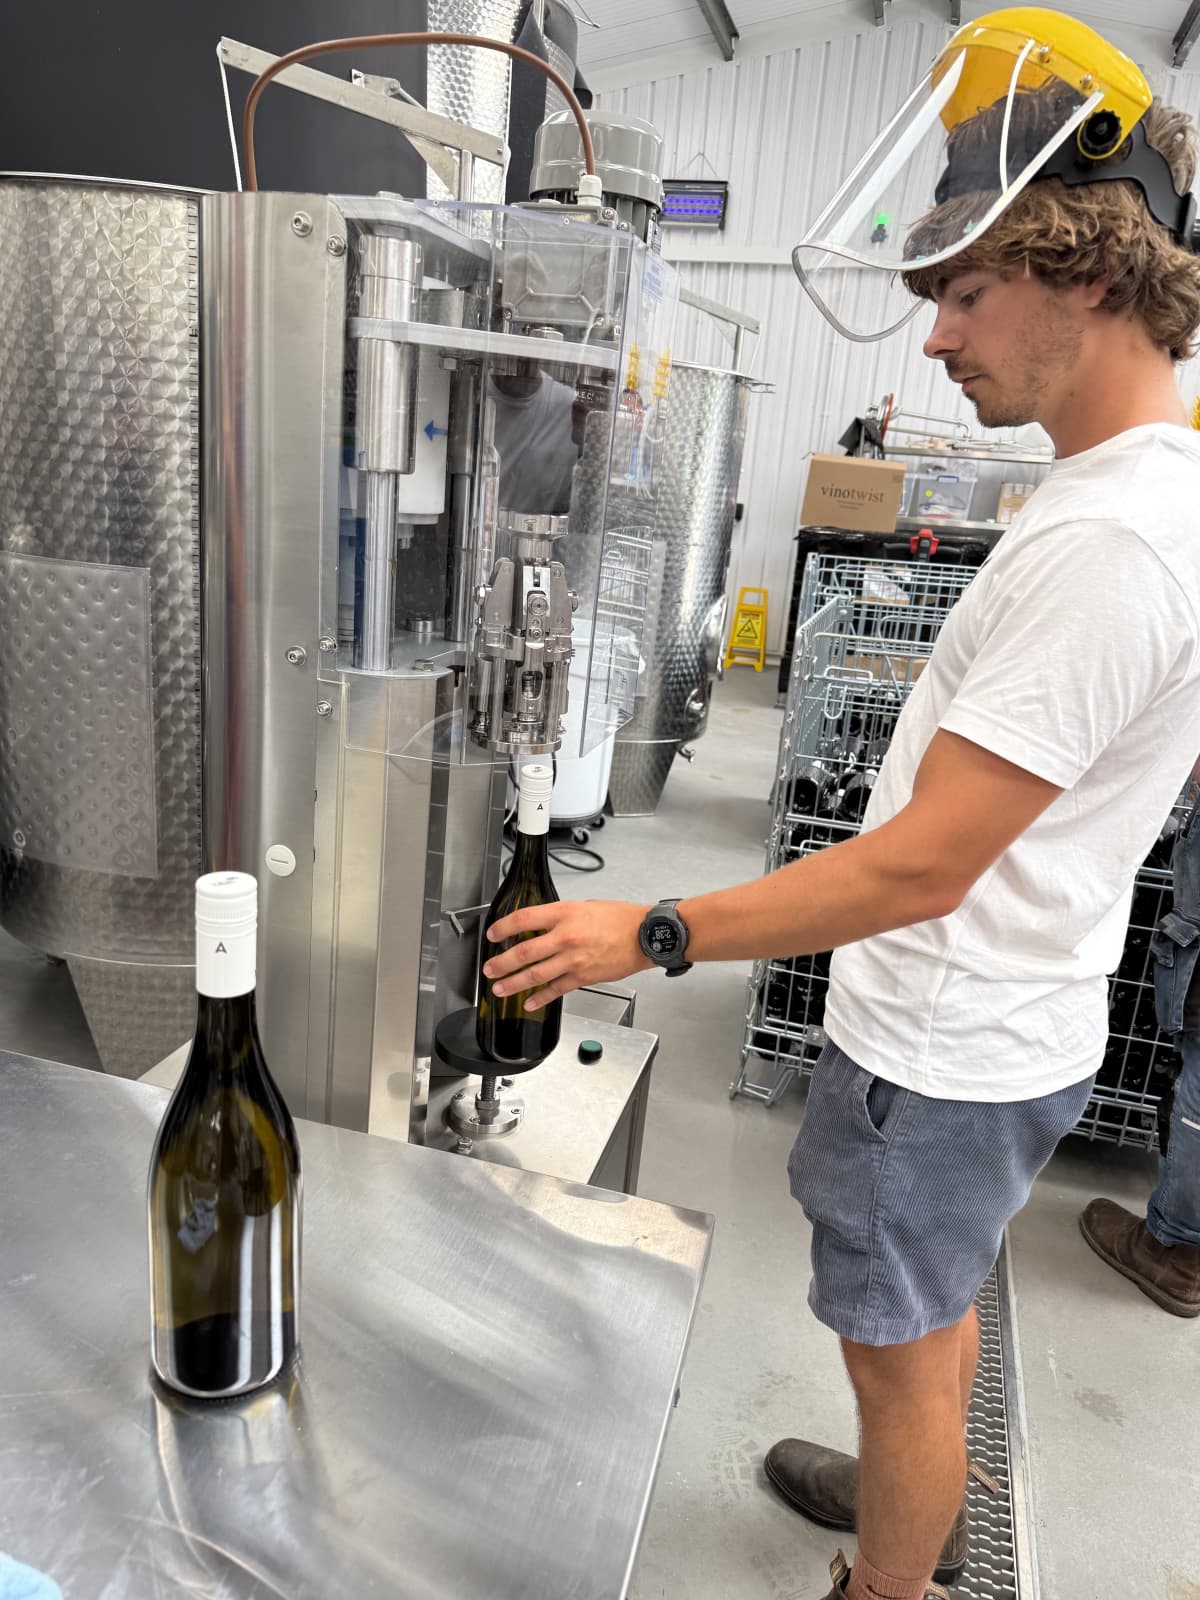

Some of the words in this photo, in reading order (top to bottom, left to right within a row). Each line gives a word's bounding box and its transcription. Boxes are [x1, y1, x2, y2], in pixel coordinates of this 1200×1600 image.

[820, 483, 884, 504] vinotwist
[536, 802, 544, 810] A
[215, 941, 228, 954] A
